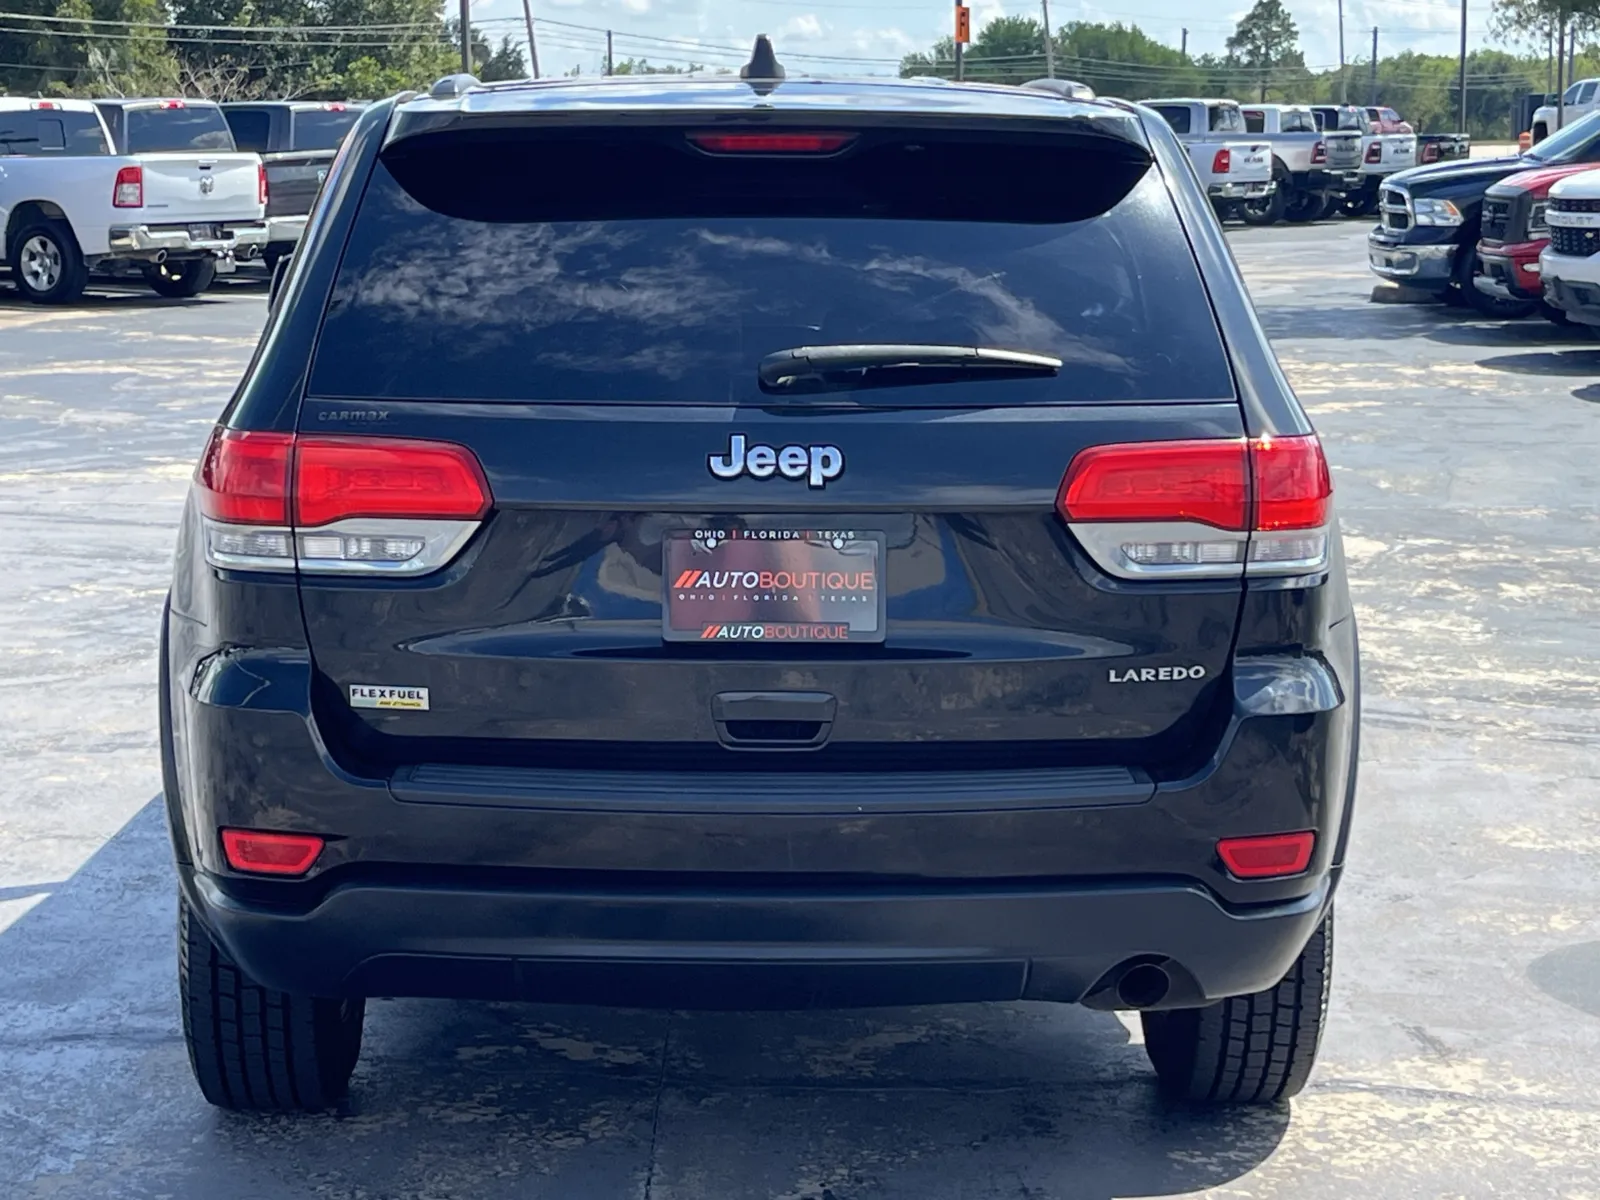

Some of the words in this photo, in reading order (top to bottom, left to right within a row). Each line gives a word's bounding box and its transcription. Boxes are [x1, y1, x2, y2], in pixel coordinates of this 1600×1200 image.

[708, 434, 844, 488] Jeep
[694, 530, 726, 539] OHIO
[743, 530, 800, 539] FLORIDA
[816, 530, 855, 539] TEXAS
[695, 571, 874, 590] AUTOBOUTIQUE
[716, 625, 848, 639] AUTOBOUTIQUE
[1108, 665, 1206, 682] LAREDO
[351, 687, 424, 700] FLEXFUEL
